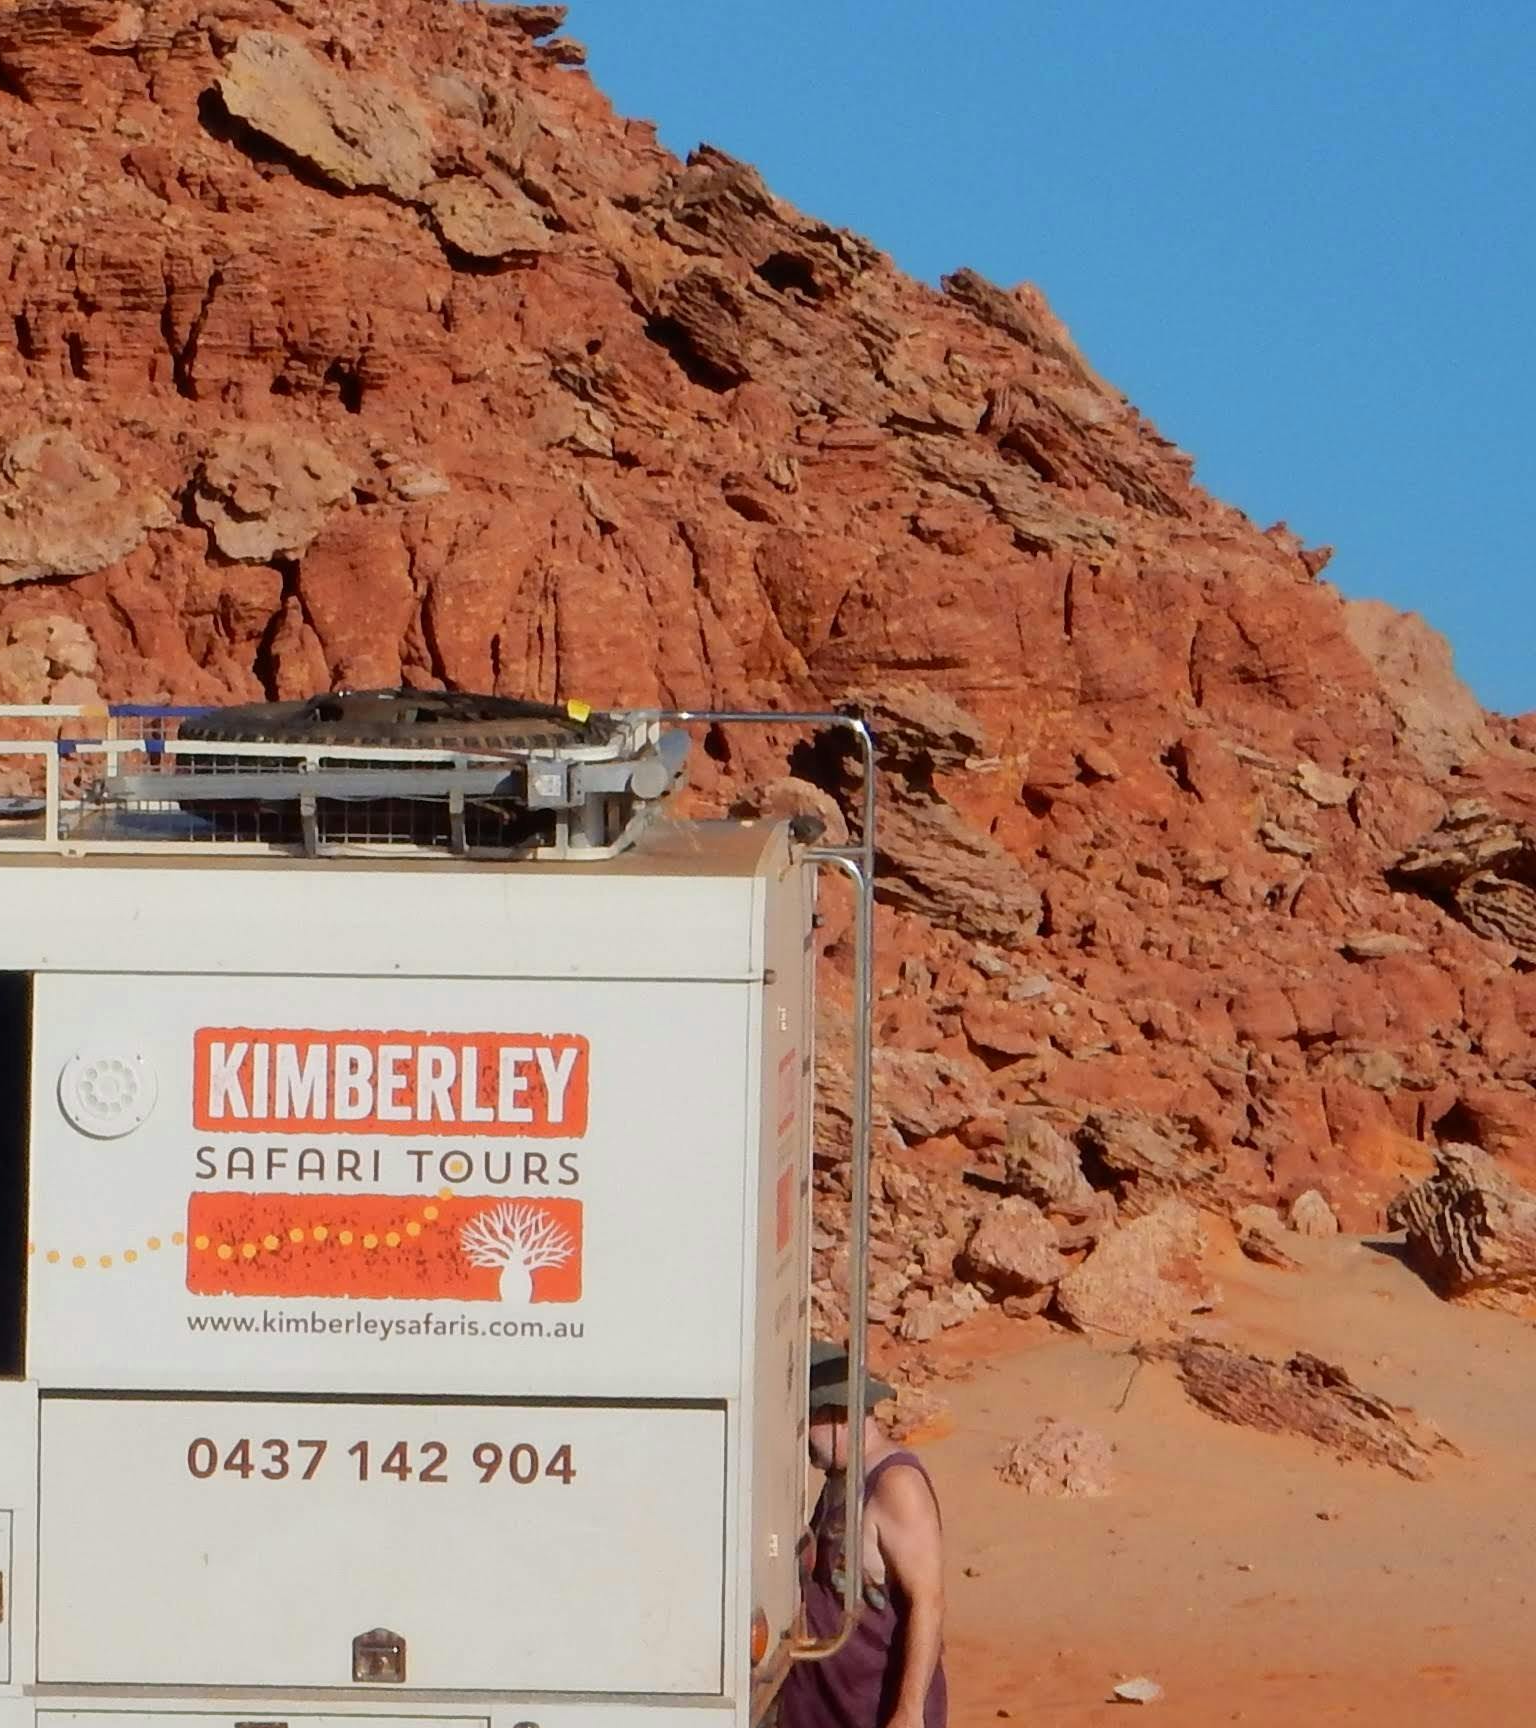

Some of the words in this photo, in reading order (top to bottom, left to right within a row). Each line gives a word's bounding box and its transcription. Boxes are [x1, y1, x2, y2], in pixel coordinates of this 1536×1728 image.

[206, 1041, 578, 1124] KIMBERLEY
[194, 1146, 382, 1183] SAFARI
[406, 1149, 581, 1186] TOURS
[186, 1311, 585, 1341] www.kimberleysafaris.com.au
[186, 1437, 328, 1481] 0437
[346, 1440, 449, 1483] 142
[471, 1442, 577, 1485] 904
